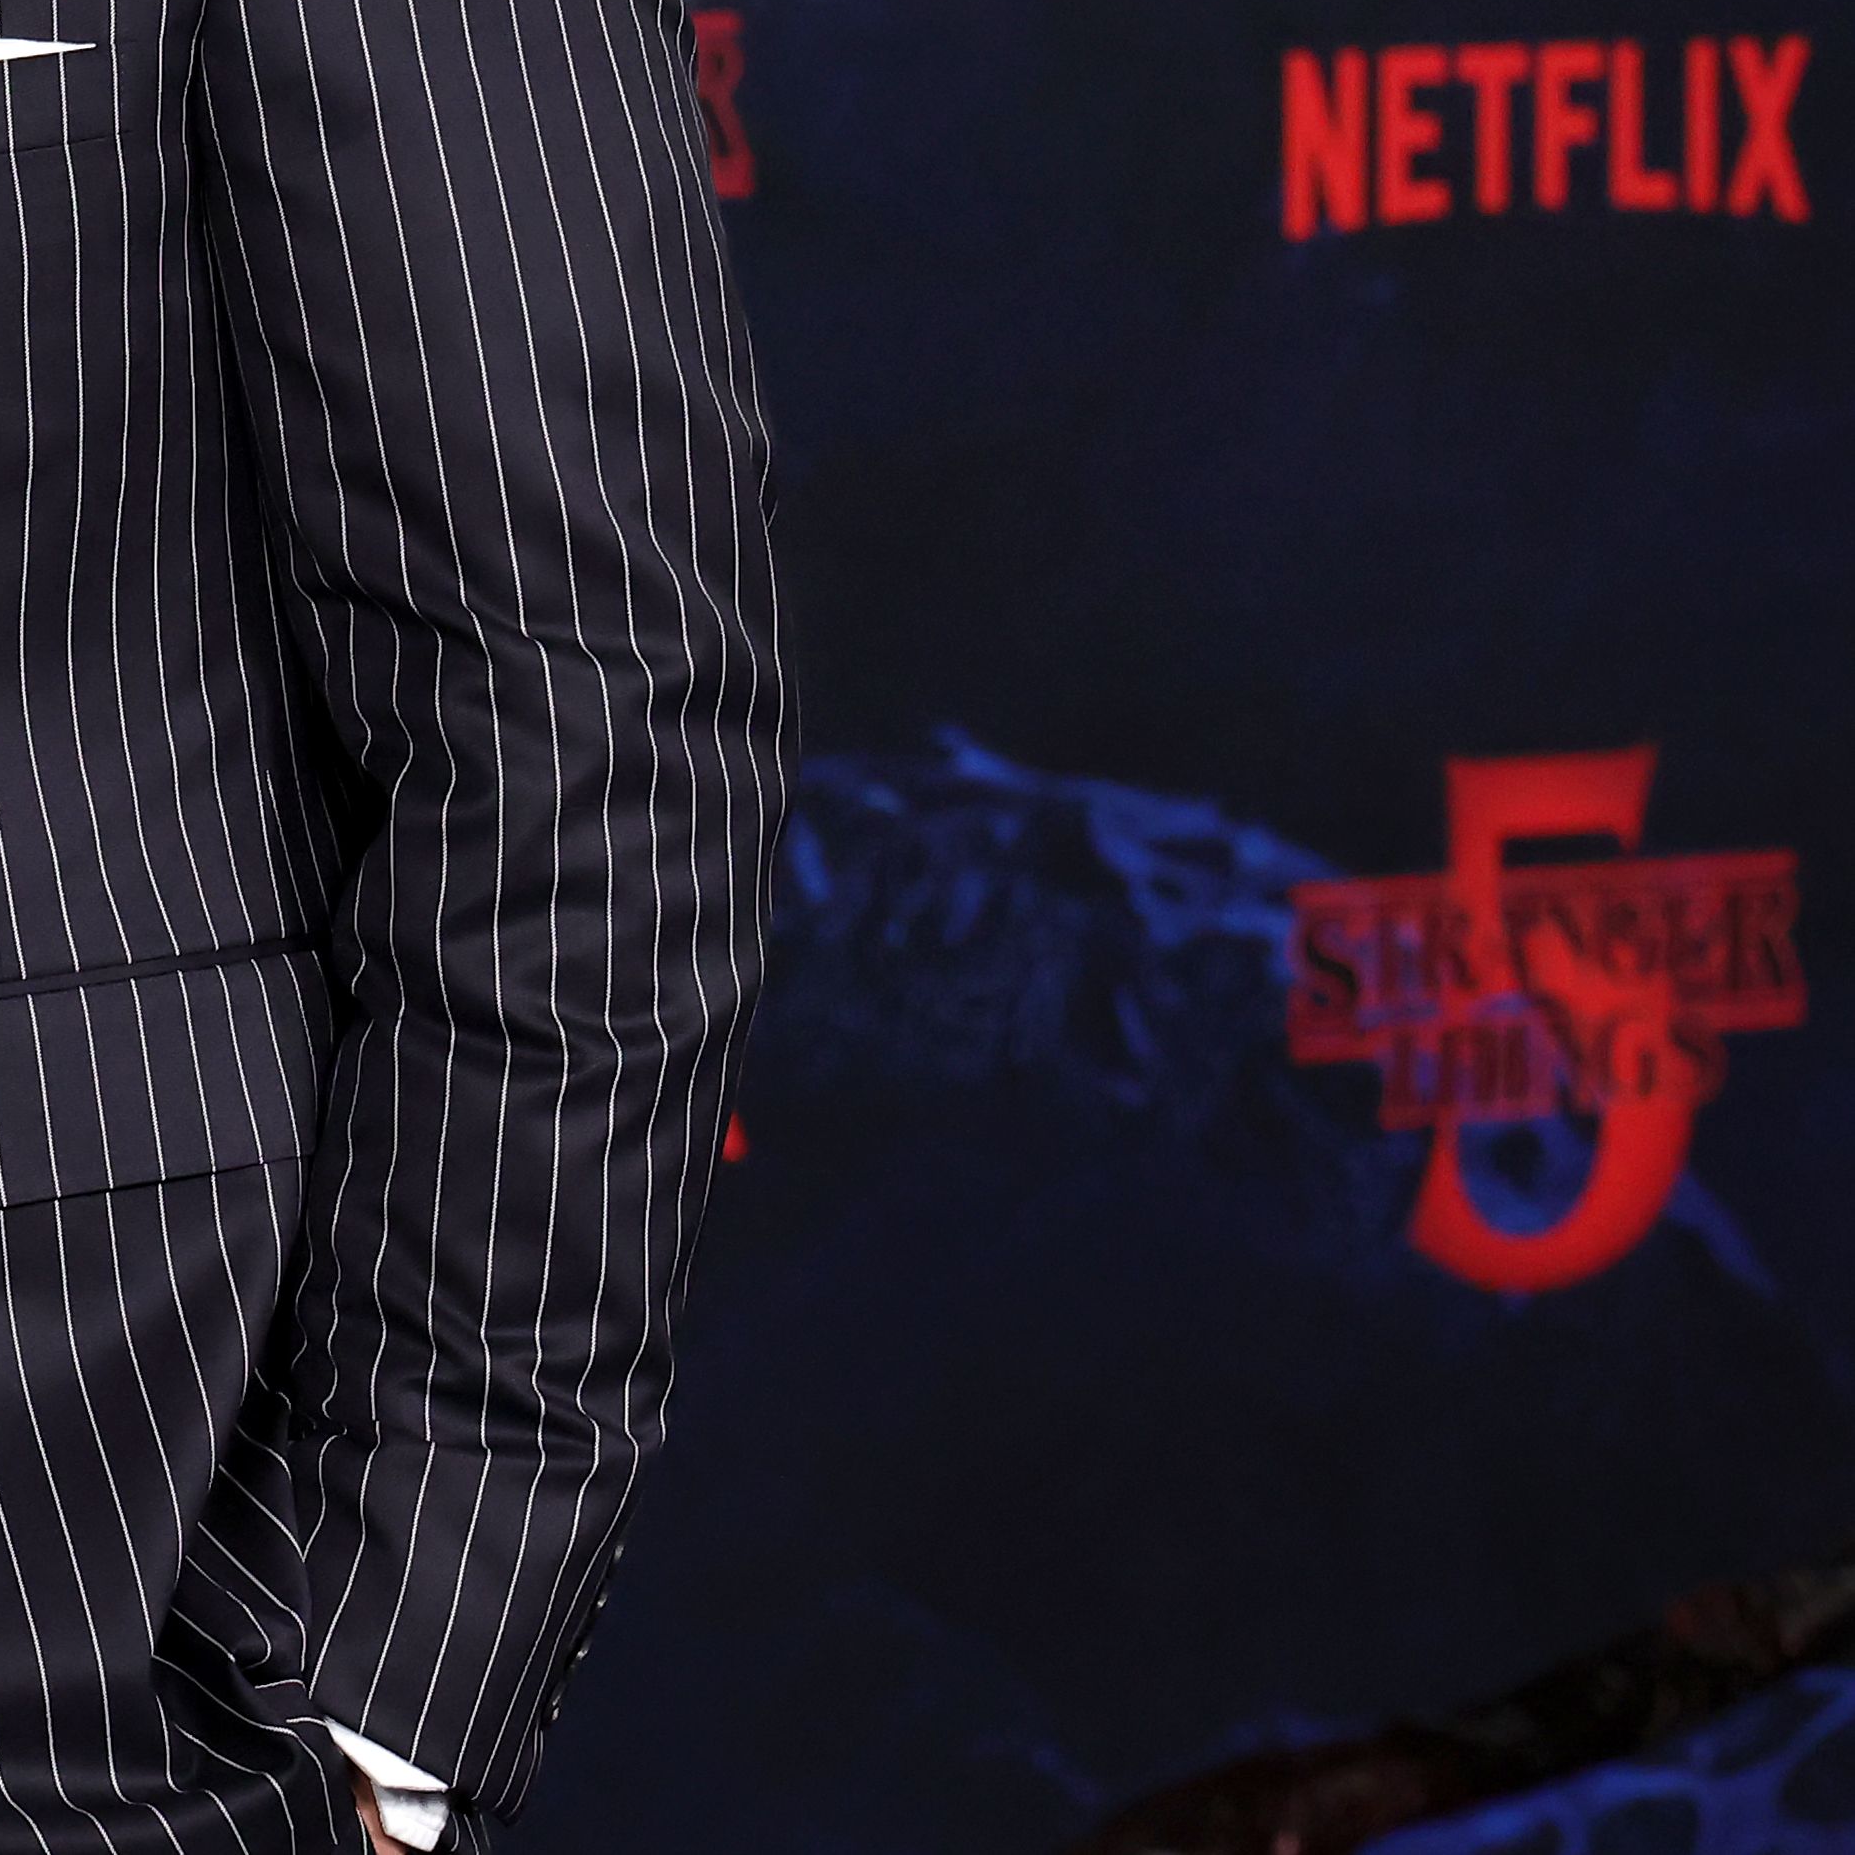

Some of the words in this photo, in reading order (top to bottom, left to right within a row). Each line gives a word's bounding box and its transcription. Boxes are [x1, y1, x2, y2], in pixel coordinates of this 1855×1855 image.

[1281, 32, 1811, 244] NETFLIX
[1286, 856, 1809, 1058] STRANGER
[1378, 1006, 1729, 1132] THINGS
